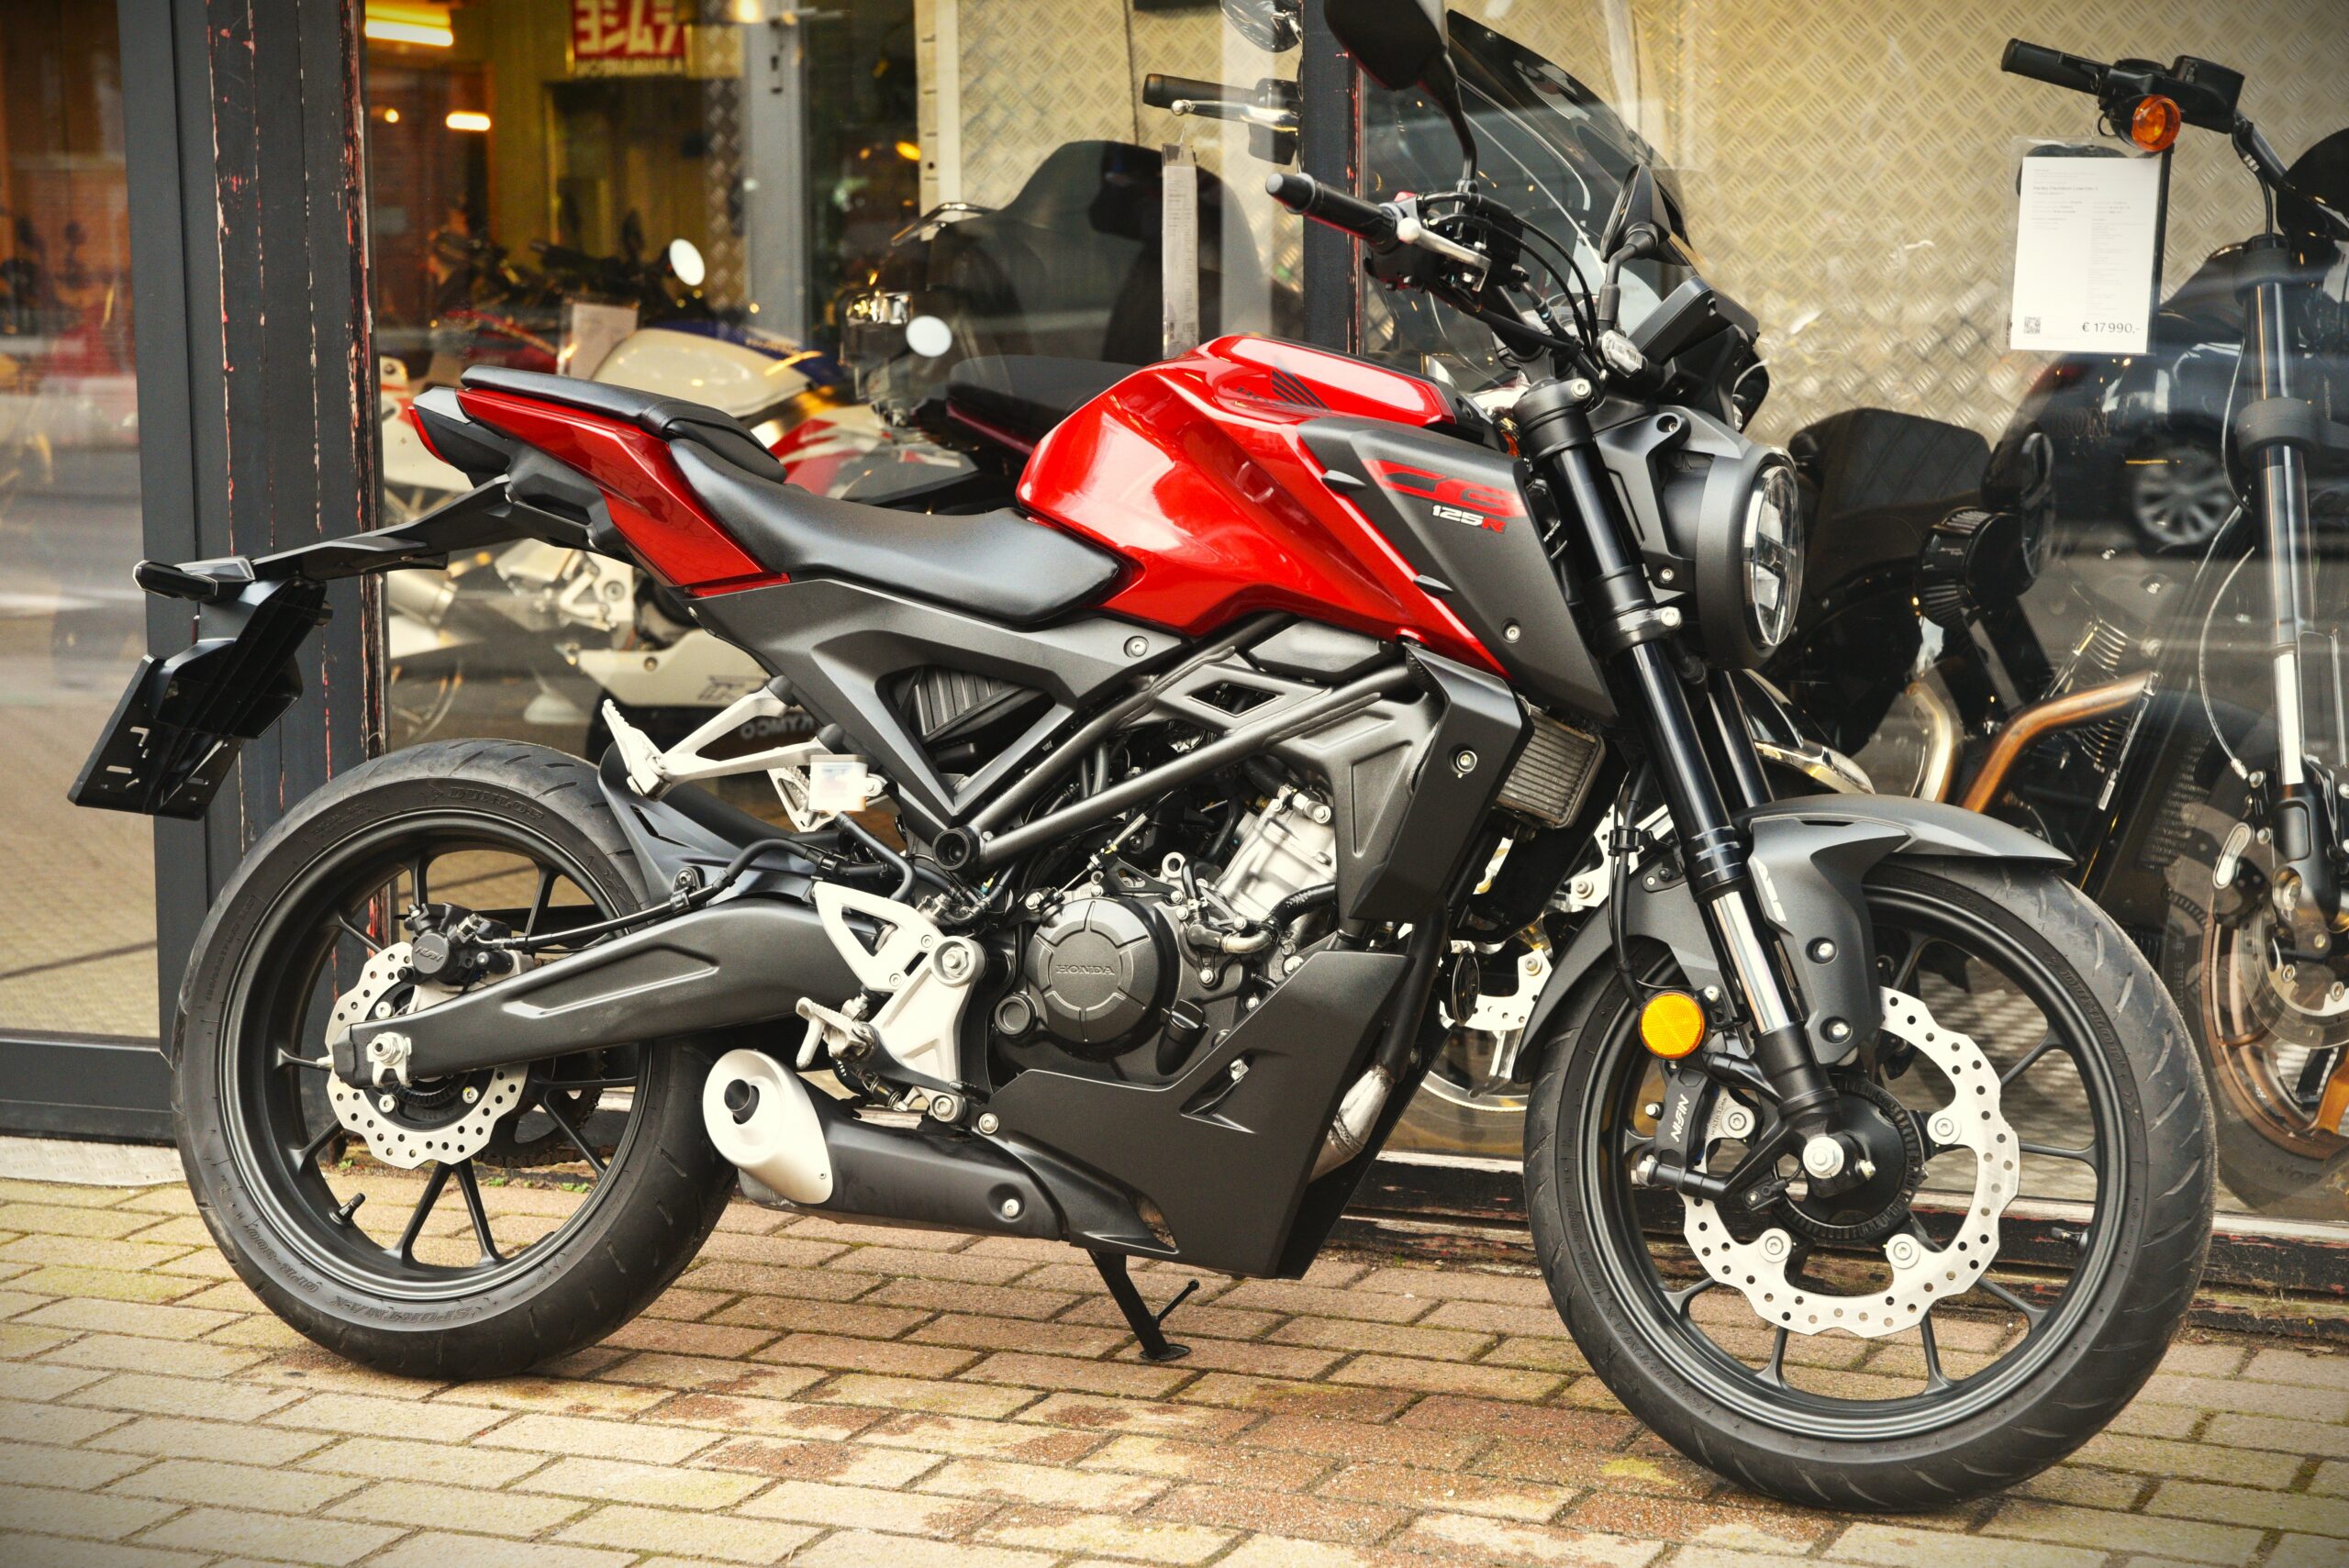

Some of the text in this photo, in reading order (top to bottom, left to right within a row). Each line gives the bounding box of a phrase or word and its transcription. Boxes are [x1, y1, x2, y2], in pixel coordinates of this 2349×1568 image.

[1431, 505, 1508, 533] 125R
[448, 786, 545, 820] DUNLOP
[1055, 964, 1116, 975] HONDA
[1670, 1093, 1690, 1143] NISSIN
